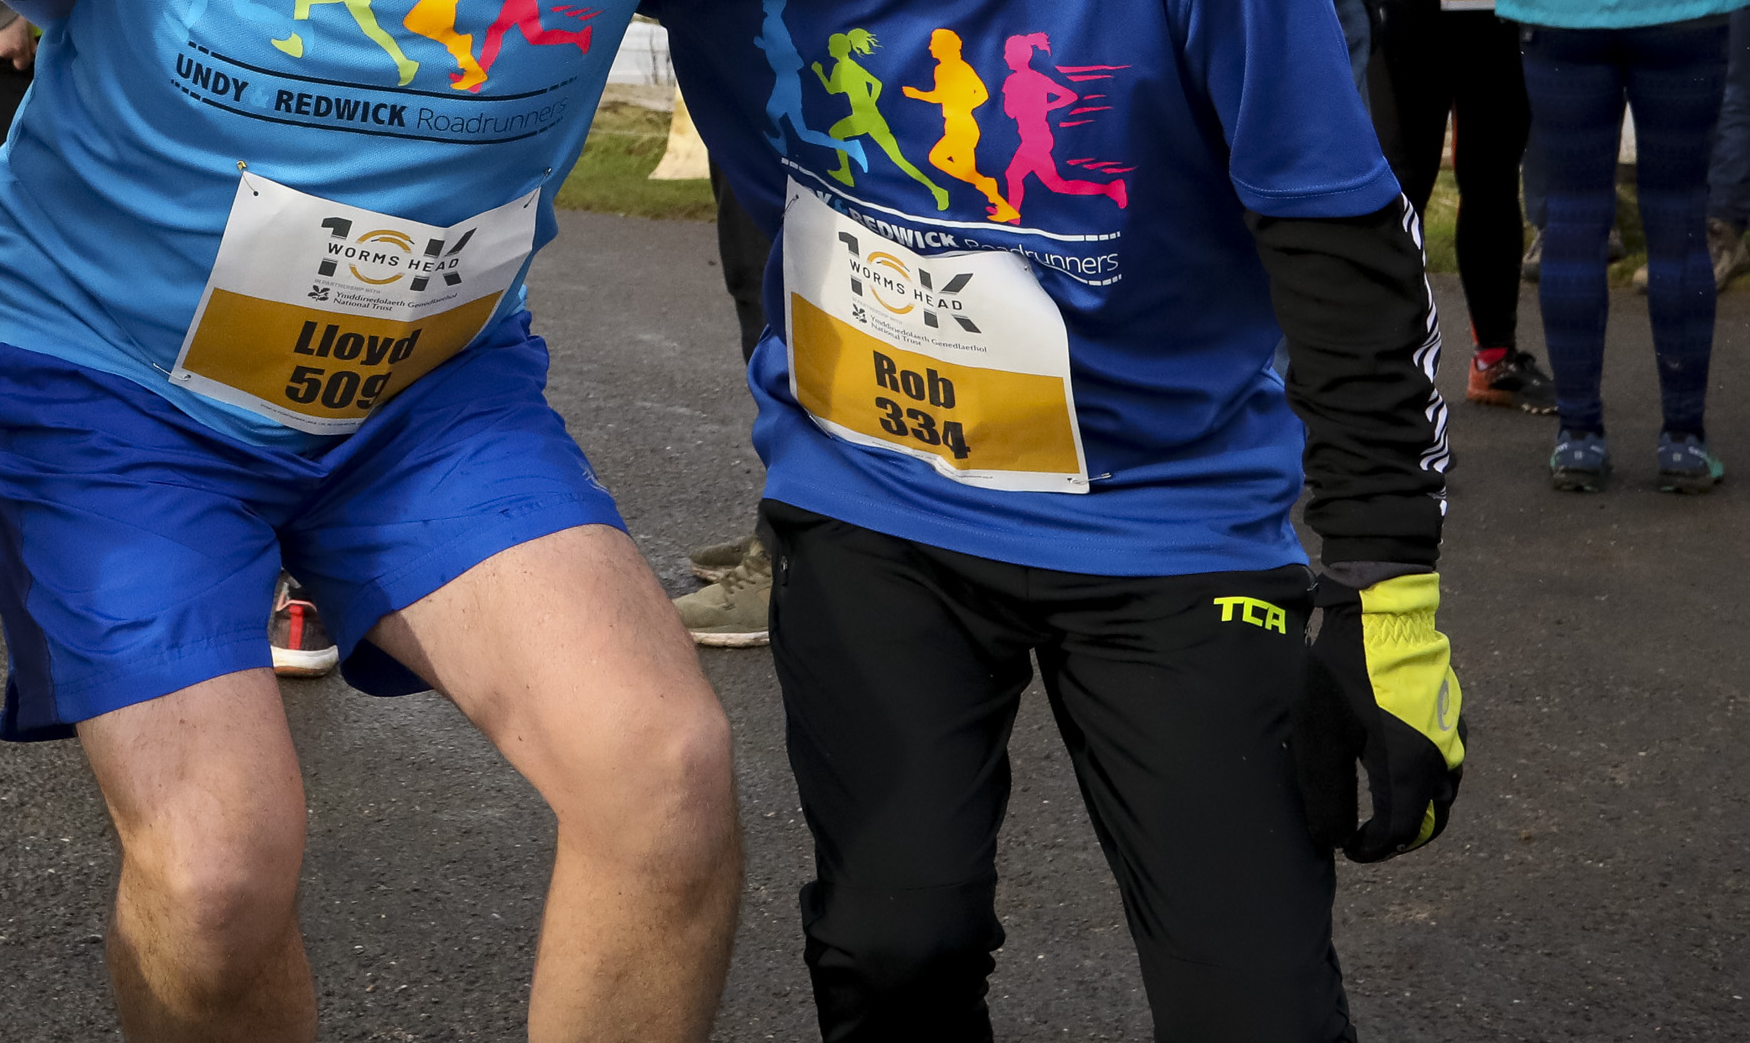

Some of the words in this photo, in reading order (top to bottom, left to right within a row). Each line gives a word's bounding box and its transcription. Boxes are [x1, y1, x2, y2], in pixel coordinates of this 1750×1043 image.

[176, 53, 249, 102] UNDY
[274, 89, 408, 127] REDWICK
[417, 94, 569, 135] Roadrunners
[849, 208, 960, 249] REDWICK
[318, 217, 478, 292] 10K
[328, 243, 400, 267] WORMS
[408, 258, 459, 273] HEAD
[333, 298, 371, 310] National
[372, 303, 393, 312] Trust
[838, 231, 982, 334] 10K
[849, 259, 905, 295] WORMS
[913, 289, 963, 311] HEAD
[293, 320, 422, 366] Lloyd
[902, 336, 922, 347] Trust
[285, 365, 392, 409] 509
[872, 350, 956, 410] Rob
[874, 396, 971, 460] 334
[1213, 596, 1286, 634] TCA
